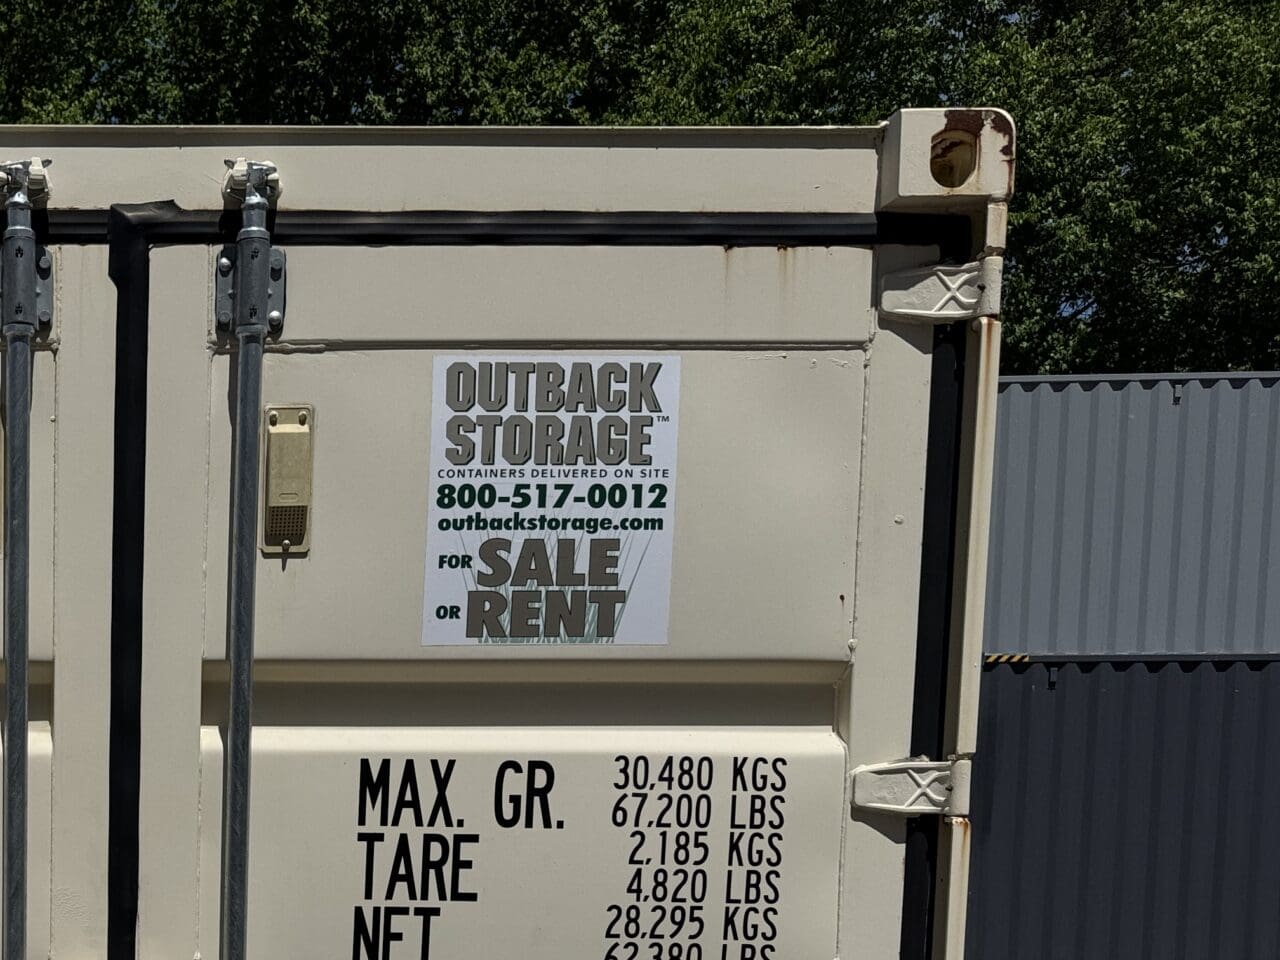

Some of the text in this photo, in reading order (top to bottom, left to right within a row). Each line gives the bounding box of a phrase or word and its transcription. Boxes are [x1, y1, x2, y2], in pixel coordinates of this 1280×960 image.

[445, 361, 663, 413] OUTBACK
[445, 414, 653, 466] STORAGE
[437, 468, 670, 479] CONTAINERS DELIVERED ON SITE
[436, 483, 668, 509] 800-517-0012
[437, 512, 664, 534] outbackstorage.com
[438, 537, 621, 588] FOR SALE
[435, 590, 626, 638] OR RENT
[357, 755, 788, 829] MAX. GR. 30,480 KGS
[611, 793, 785, 830] 67,200 LBS
[357, 830, 784, 902] TARE 2,185 KGS
[626, 868, 781, 905] 4,820 LBS
[604, 904, 705, 941] 28,295
[722, 906, 779, 942] KGS
